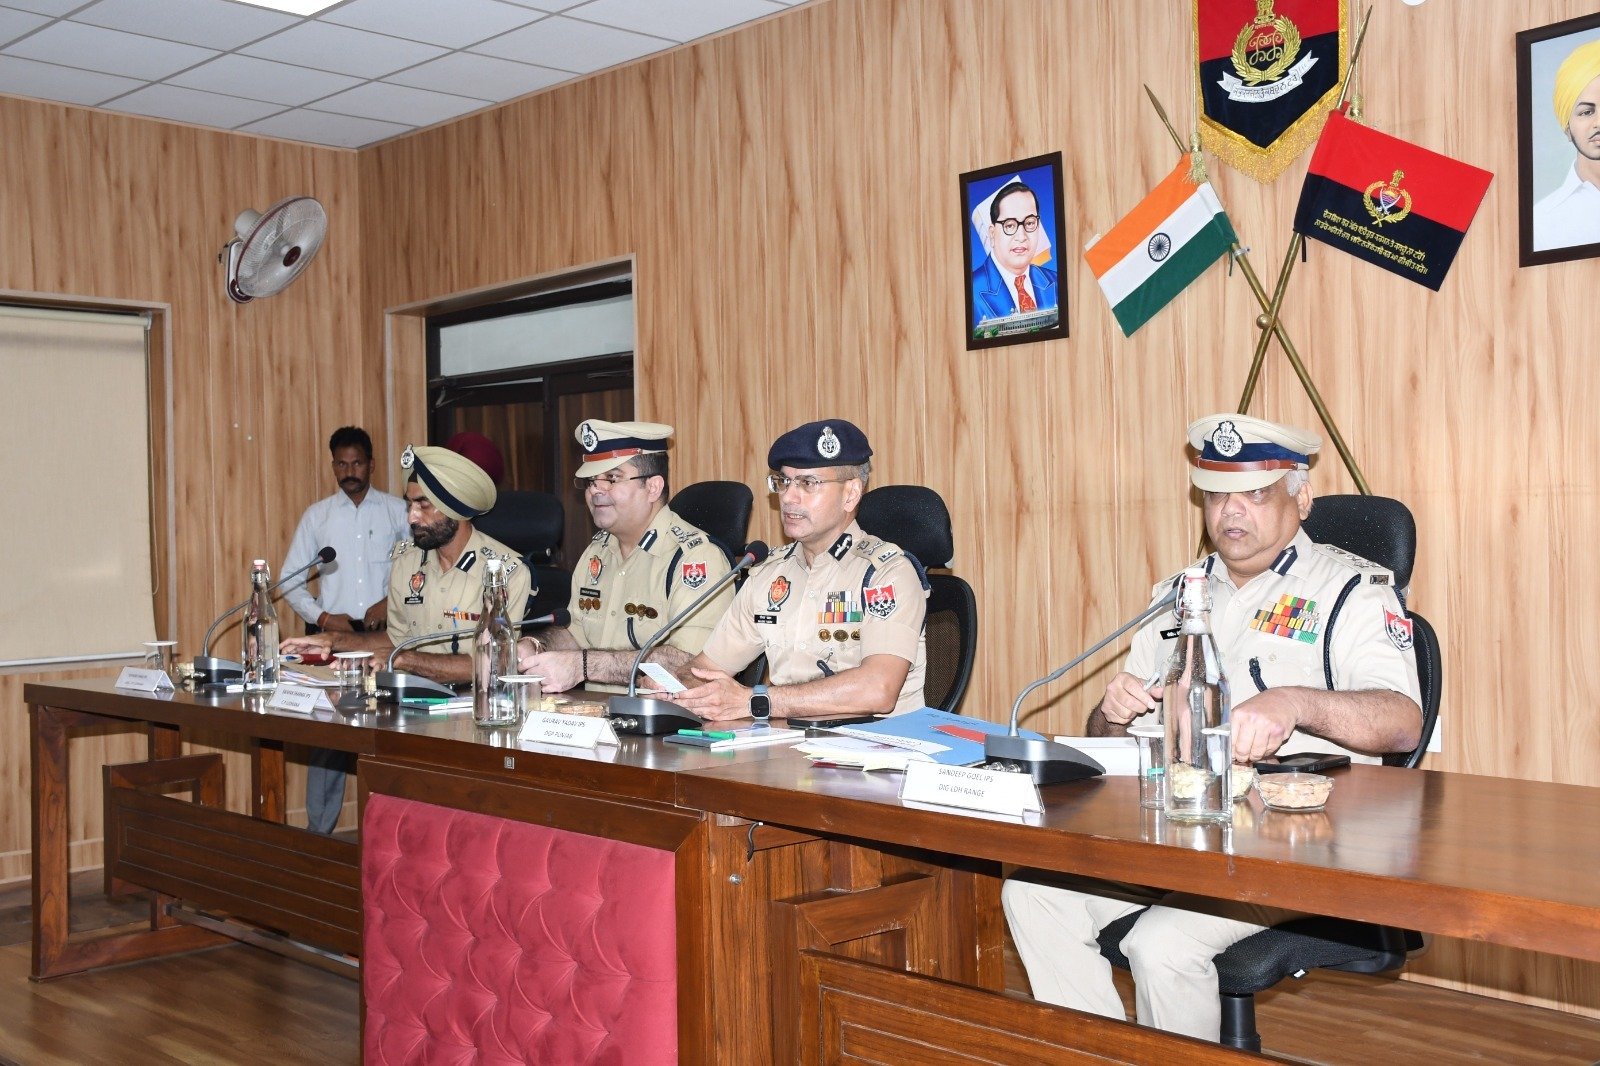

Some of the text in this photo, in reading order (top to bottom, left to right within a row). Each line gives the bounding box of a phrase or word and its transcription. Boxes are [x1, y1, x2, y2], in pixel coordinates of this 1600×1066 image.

[938, 768, 966, 777] SANDEEP
[966, 772, 983, 781] GOEL
[938, 783, 986, 798] DIG LDH RANGE
